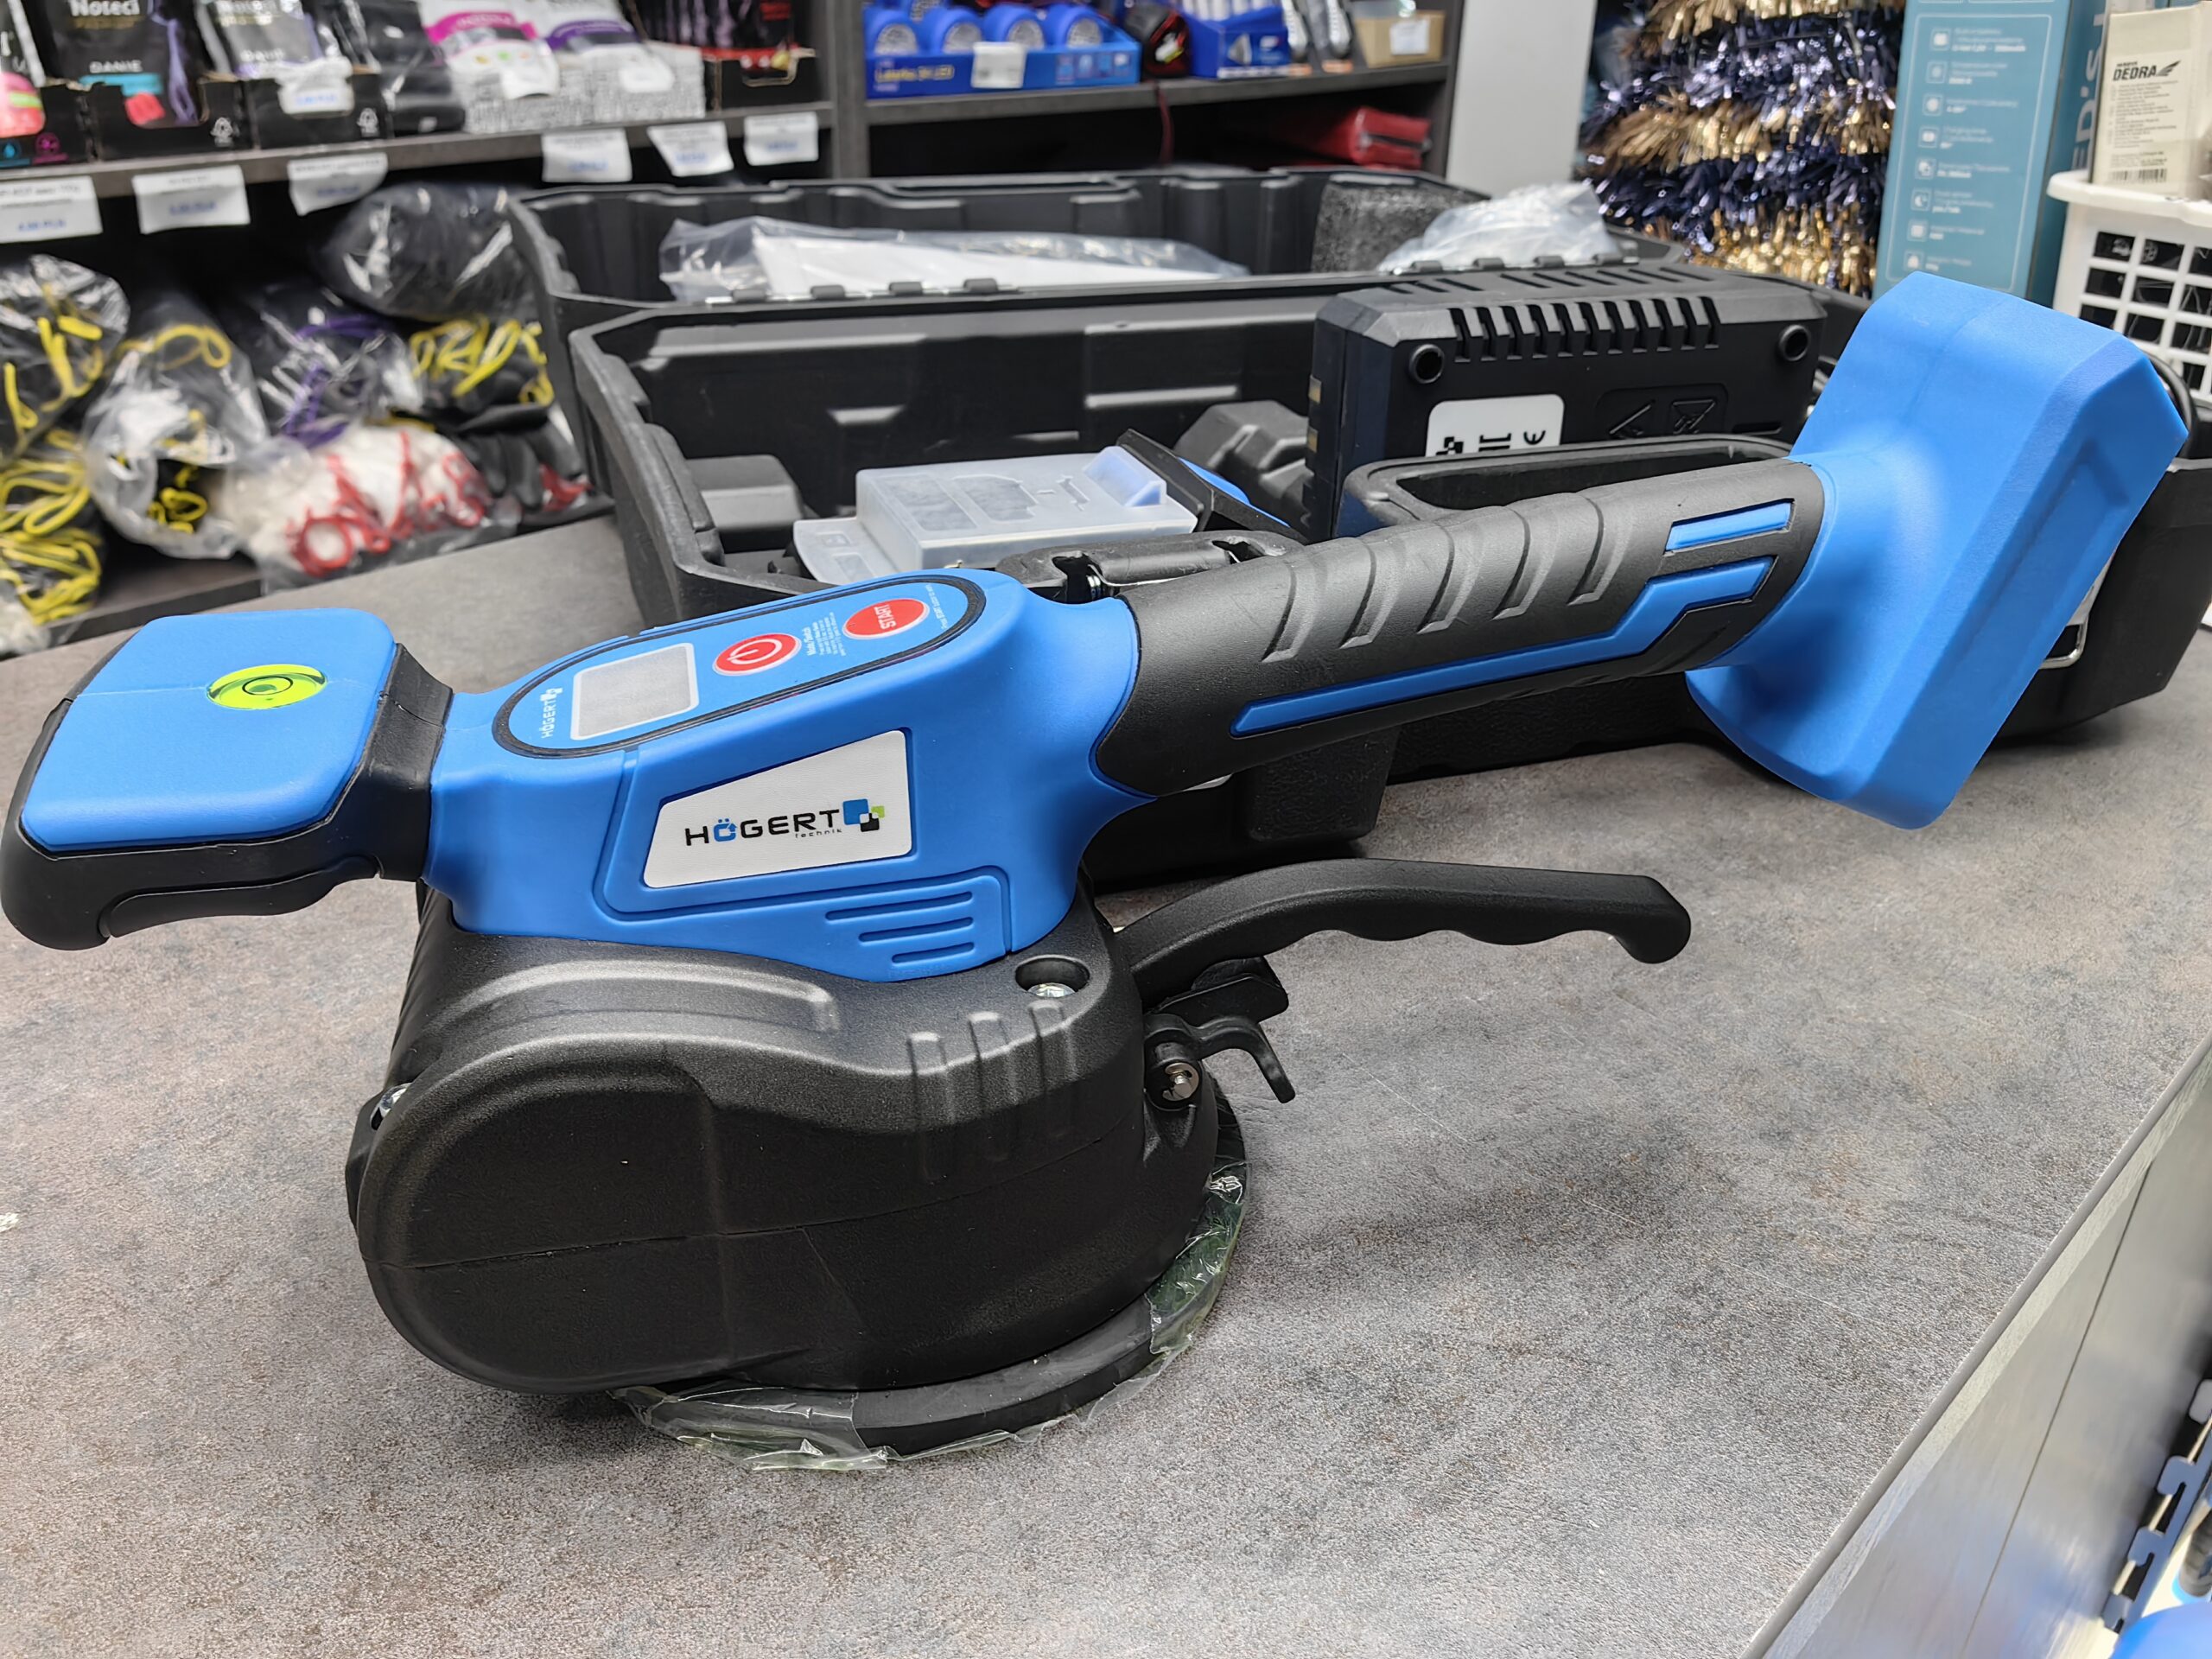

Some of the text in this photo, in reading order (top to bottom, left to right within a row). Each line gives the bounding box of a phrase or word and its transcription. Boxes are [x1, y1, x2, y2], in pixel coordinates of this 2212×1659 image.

[2113, 65, 2157, 81] DEDRA
[874, 604, 896, 631] START
[539, 697, 556, 739] HÖGERT
[685, 809, 840, 846] HÖGERT
[795, 828, 842, 838] technik
